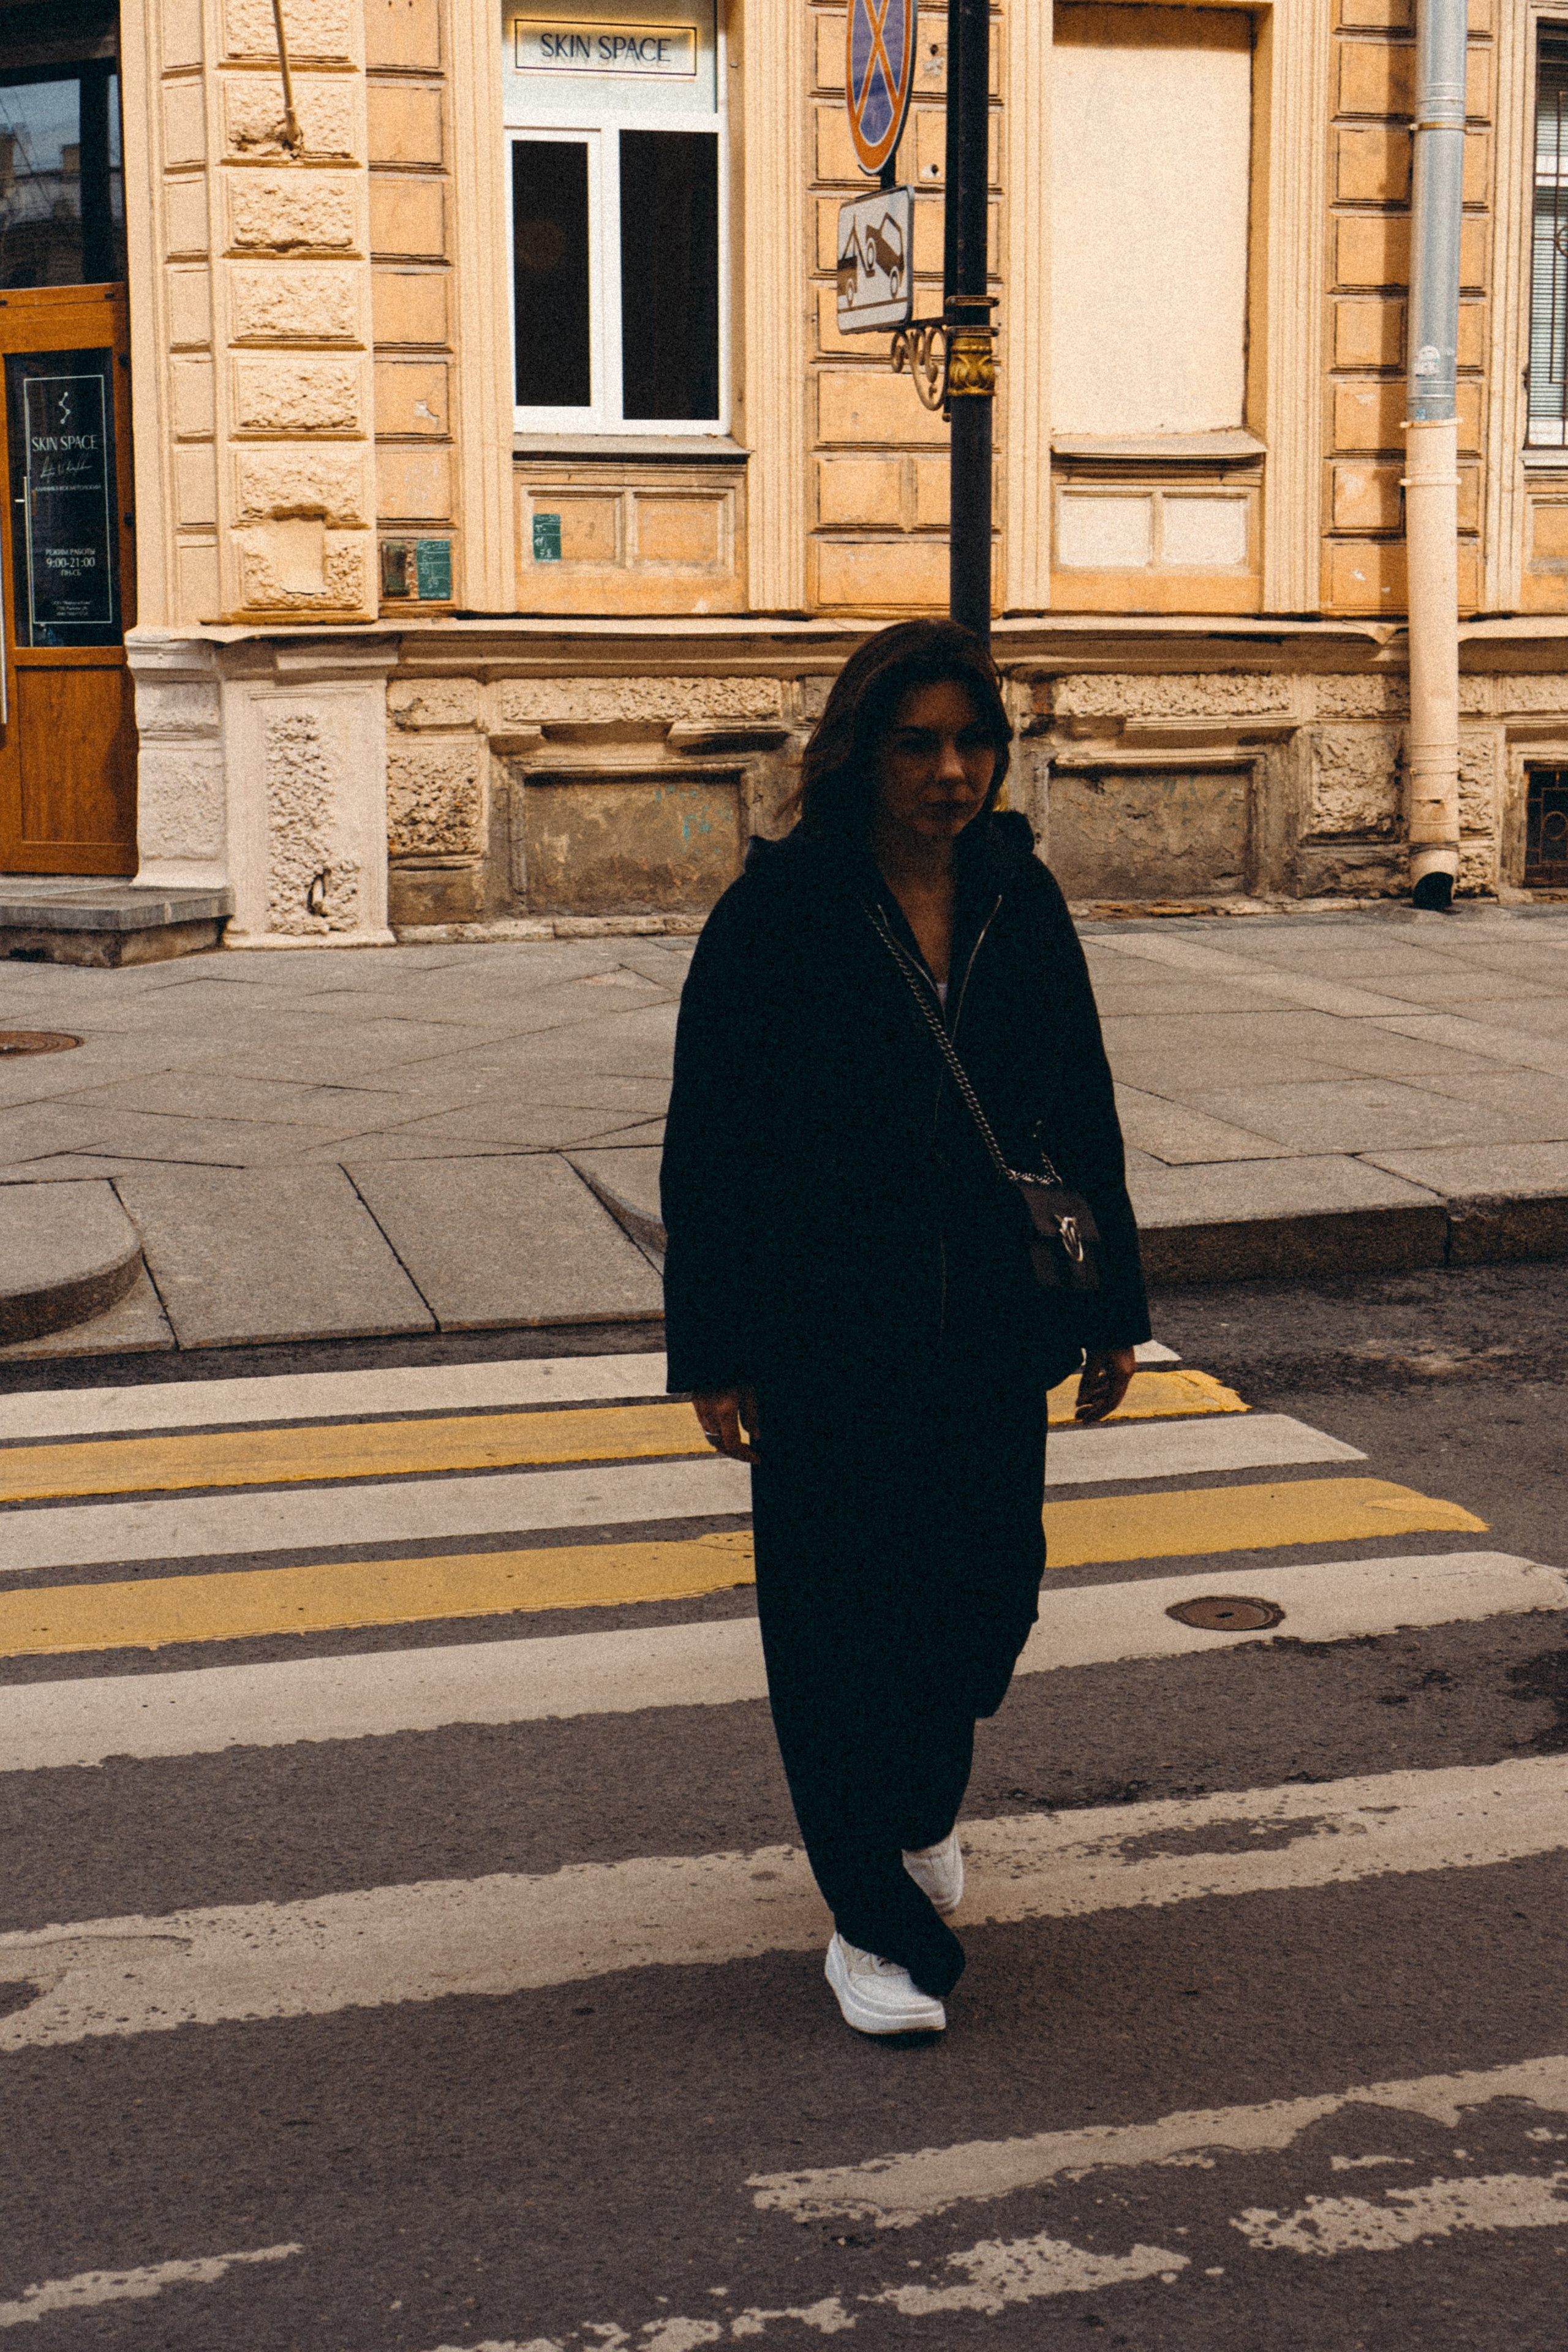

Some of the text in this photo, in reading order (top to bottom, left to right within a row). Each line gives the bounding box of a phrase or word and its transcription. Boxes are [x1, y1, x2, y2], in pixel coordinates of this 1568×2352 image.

[541, 33, 672, 62] SKIN SPACE
[31, 435, 98, 451] SKIN SPACE
[46, 557, 95, 568] 9:00-21:00
